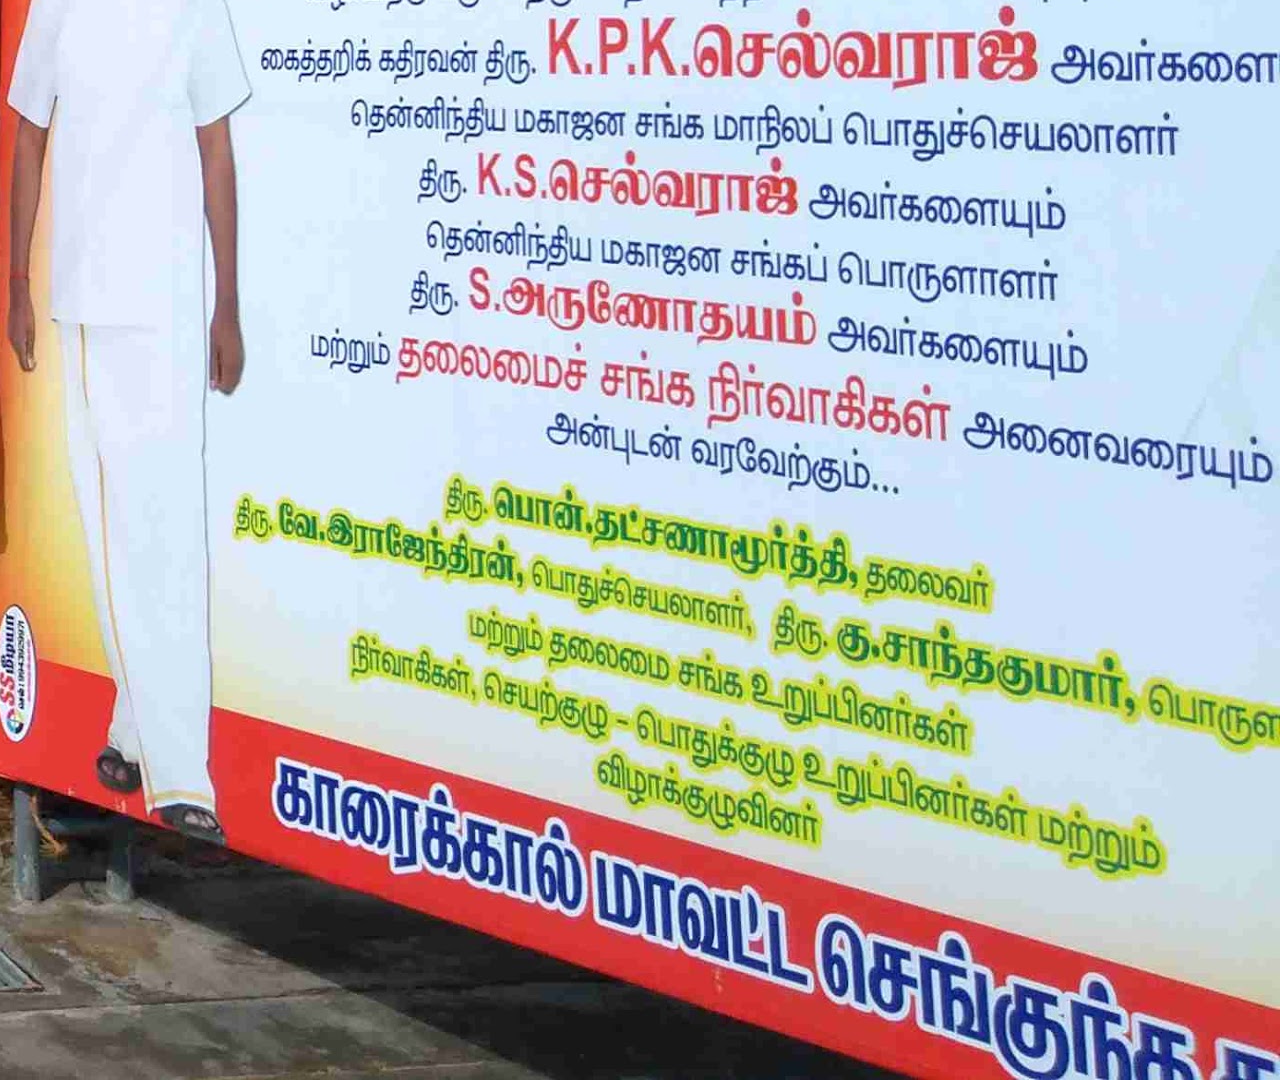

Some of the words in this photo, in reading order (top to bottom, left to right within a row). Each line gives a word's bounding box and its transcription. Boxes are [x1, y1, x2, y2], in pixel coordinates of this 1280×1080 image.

[260, 37, 373, 84] கைத்தறிக்
[378, 39, 479, 80] கதிரவன்
[484, 39, 537, 86] திரு.
[1051, 37, 1280, 85] அவர்களை
[350, 95, 507, 143] தென்னிந்திய
[514, 108, 626, 141] மகாஜன
[635, 101, 705, 140] சங்க
[714, 103, 832, 155] மாநிலப்
[843, 106, 1179, 162] பொதுச்செயலாளர்
[417, 158, 468, 204] திரு.
[808, 180, 1067, 239] அவர்களையும்
[425, 219, 592, 272] தென்னிந்திய
[601, 233, 722, 277] மகாஜன
[730, 239, 829, 284] சங்கப்
[838, 250, 1058, 303] பொருளாளர்
[408, 270, 459, 315] திரு.
[827, 315, 1089, 381] அவர்களையும்
[309, 328, 391, 374] மற்றும்
[395, 336, 588, 393] தலைமைச்
[599, 349, 697, 410] சங்க
[706, 359, 951, 443] நிர்வாகிகள்
[962, 410, 1275, 490] அனைவரையும்
[545, 412, 683, 467] அன்புடன்
[864, 567, 990, 609] தலைவர்
[468, 611, 543, 655] மற்றும்
[549, 627, 671, 682] தலைமை
[677, 653, 743, 700] சங்க
[751, 672, 969, 752] உறுப்பினர்கள்
[483, 671, 609, 738] செயற்குழு
[636, 709, 796, 788] பொதுக்குழு
[802, 750, 1028, 838] உறுப்பினர்கள்
[1037, 807, 1162, 875] மற்றும்
[596, 752, 820, 845] விழாக்குழுவினர்
[273, 758, 586, 915] காரைக்கால்
[596, 857, 809, 986] மாவட்ட
